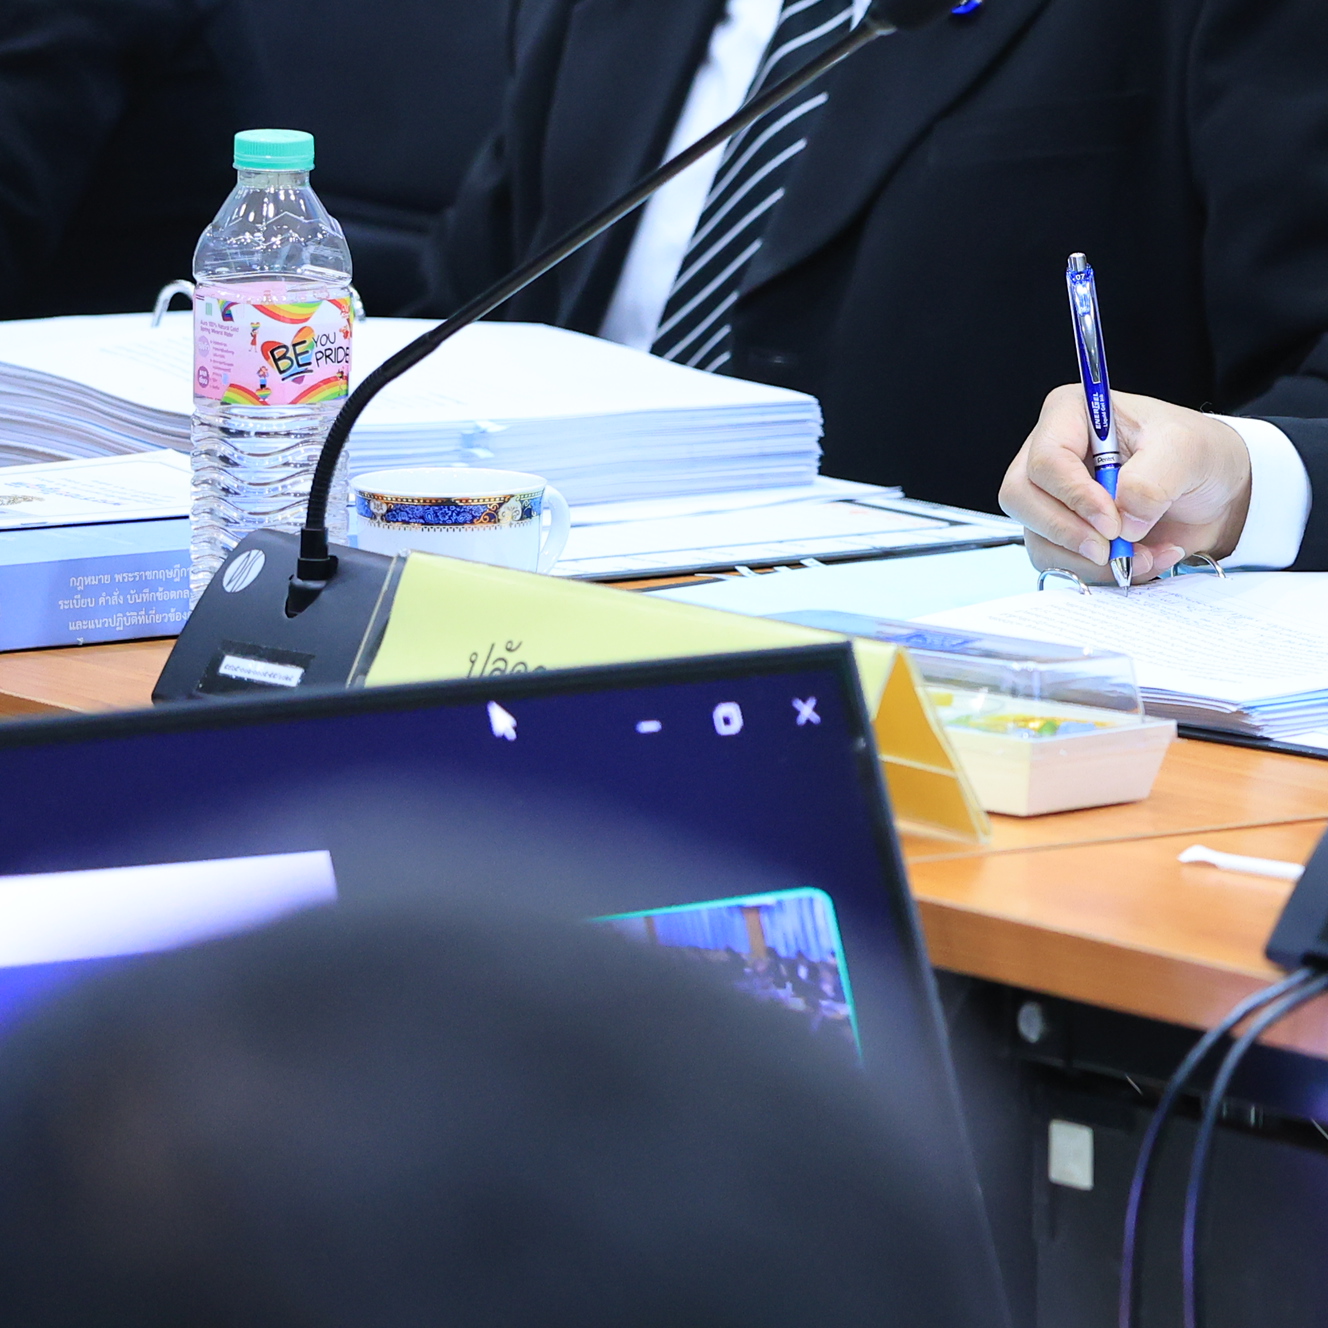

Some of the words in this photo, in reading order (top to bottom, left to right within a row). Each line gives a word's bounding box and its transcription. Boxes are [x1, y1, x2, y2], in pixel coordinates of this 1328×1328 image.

[312, 332, 336, 348] YOU
[268, 339, 313, 377] BE
[315, 346, 350, 368] PRIDE
[1091, 391, 1102, 430] ENERGEL
[69, 573, 111, 590] กฎหมาย
[58, 592, 95, 610] ระเบียบ
[99, 587, 124, 607] คำสั่ง
[127, 586, 190, 605] บันทึกข้อตกล
